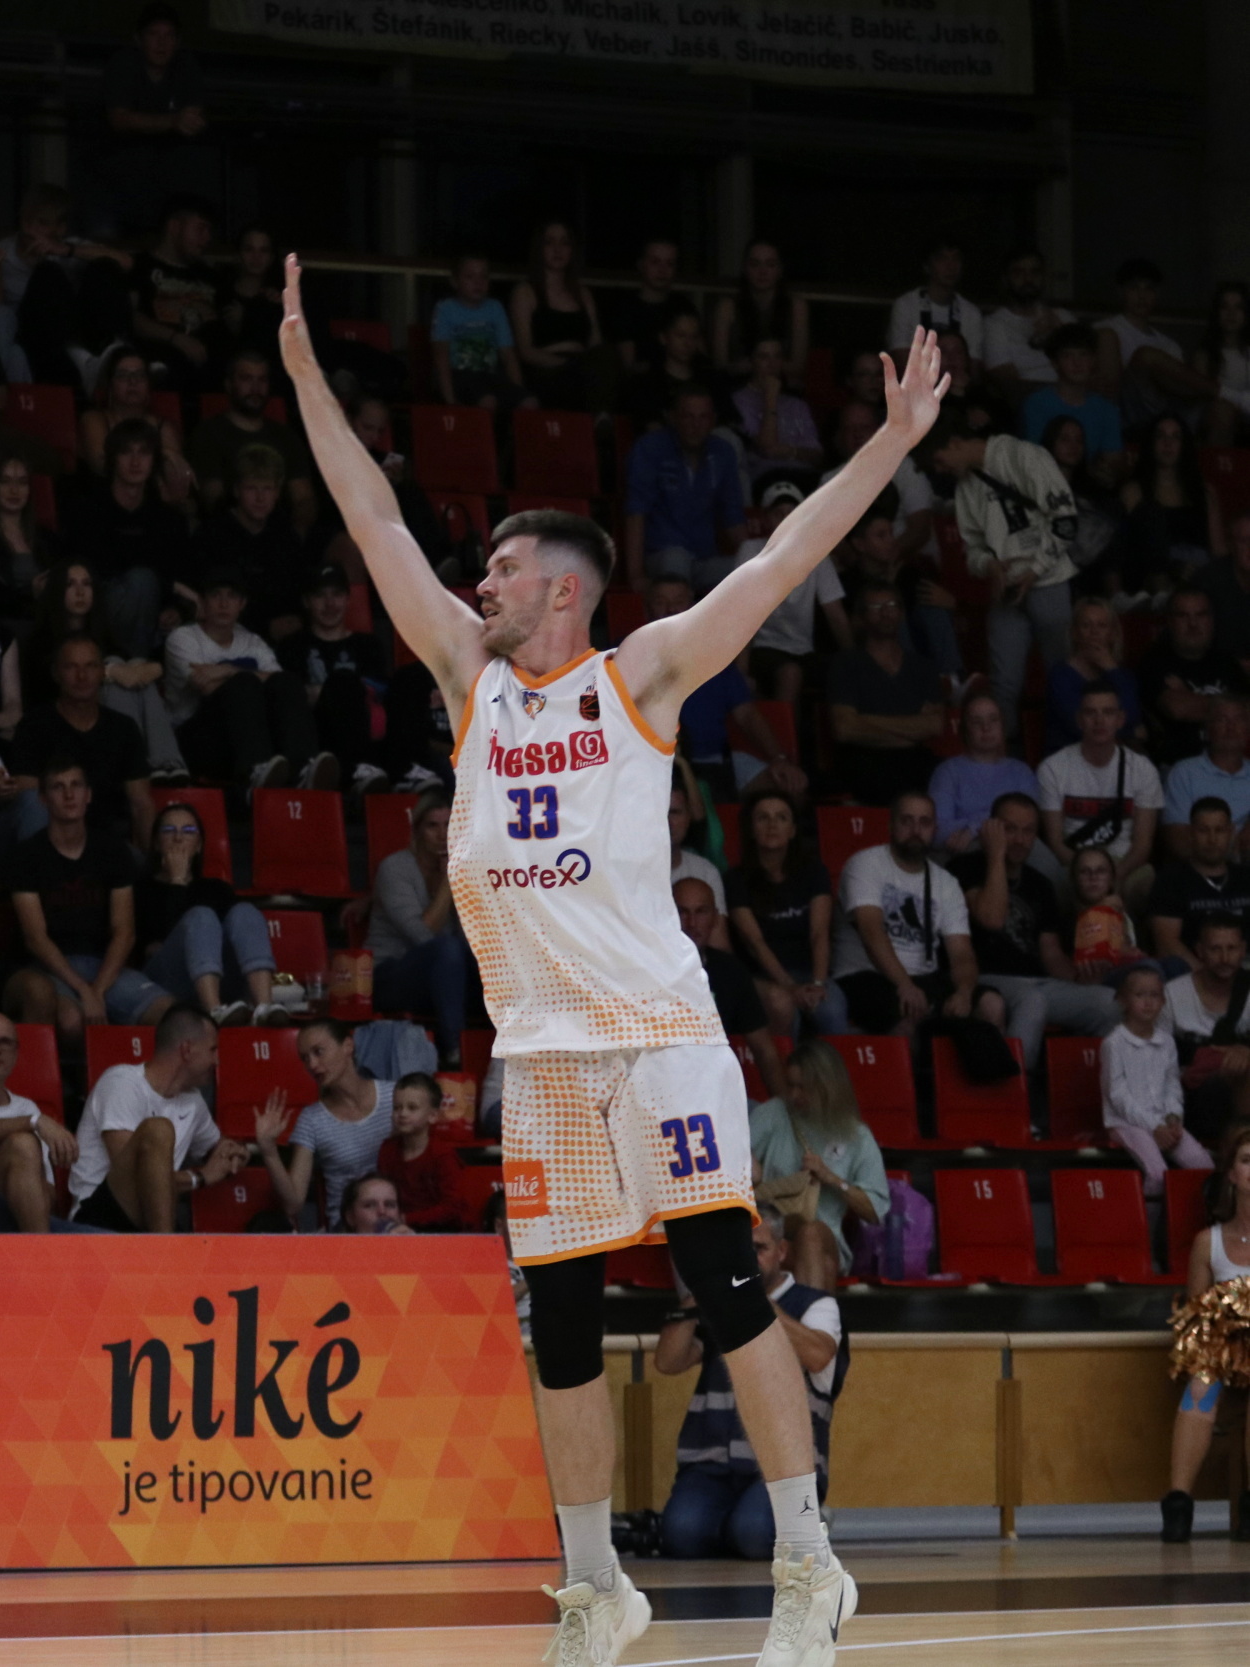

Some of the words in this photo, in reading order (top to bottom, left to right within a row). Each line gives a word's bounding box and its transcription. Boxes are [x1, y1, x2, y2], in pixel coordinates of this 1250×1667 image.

[287, 799, 302, 820] 12
[507, 785, 559, 840] 33
[131, 1036, 142, 1057] 9
[252, 1041, 271, 1060] 10
[857, 1045, 876, 1066] 15
[660, 1112, 721, 1178] 33
[234, 1185, 247, 1203] 9
[973, 1180, 994, 1200] 15
[102, 1285, 362, 1441] niké
[118, 1460, 158, 1516] je
[168, 1458, 373, 1514] tipovanie
